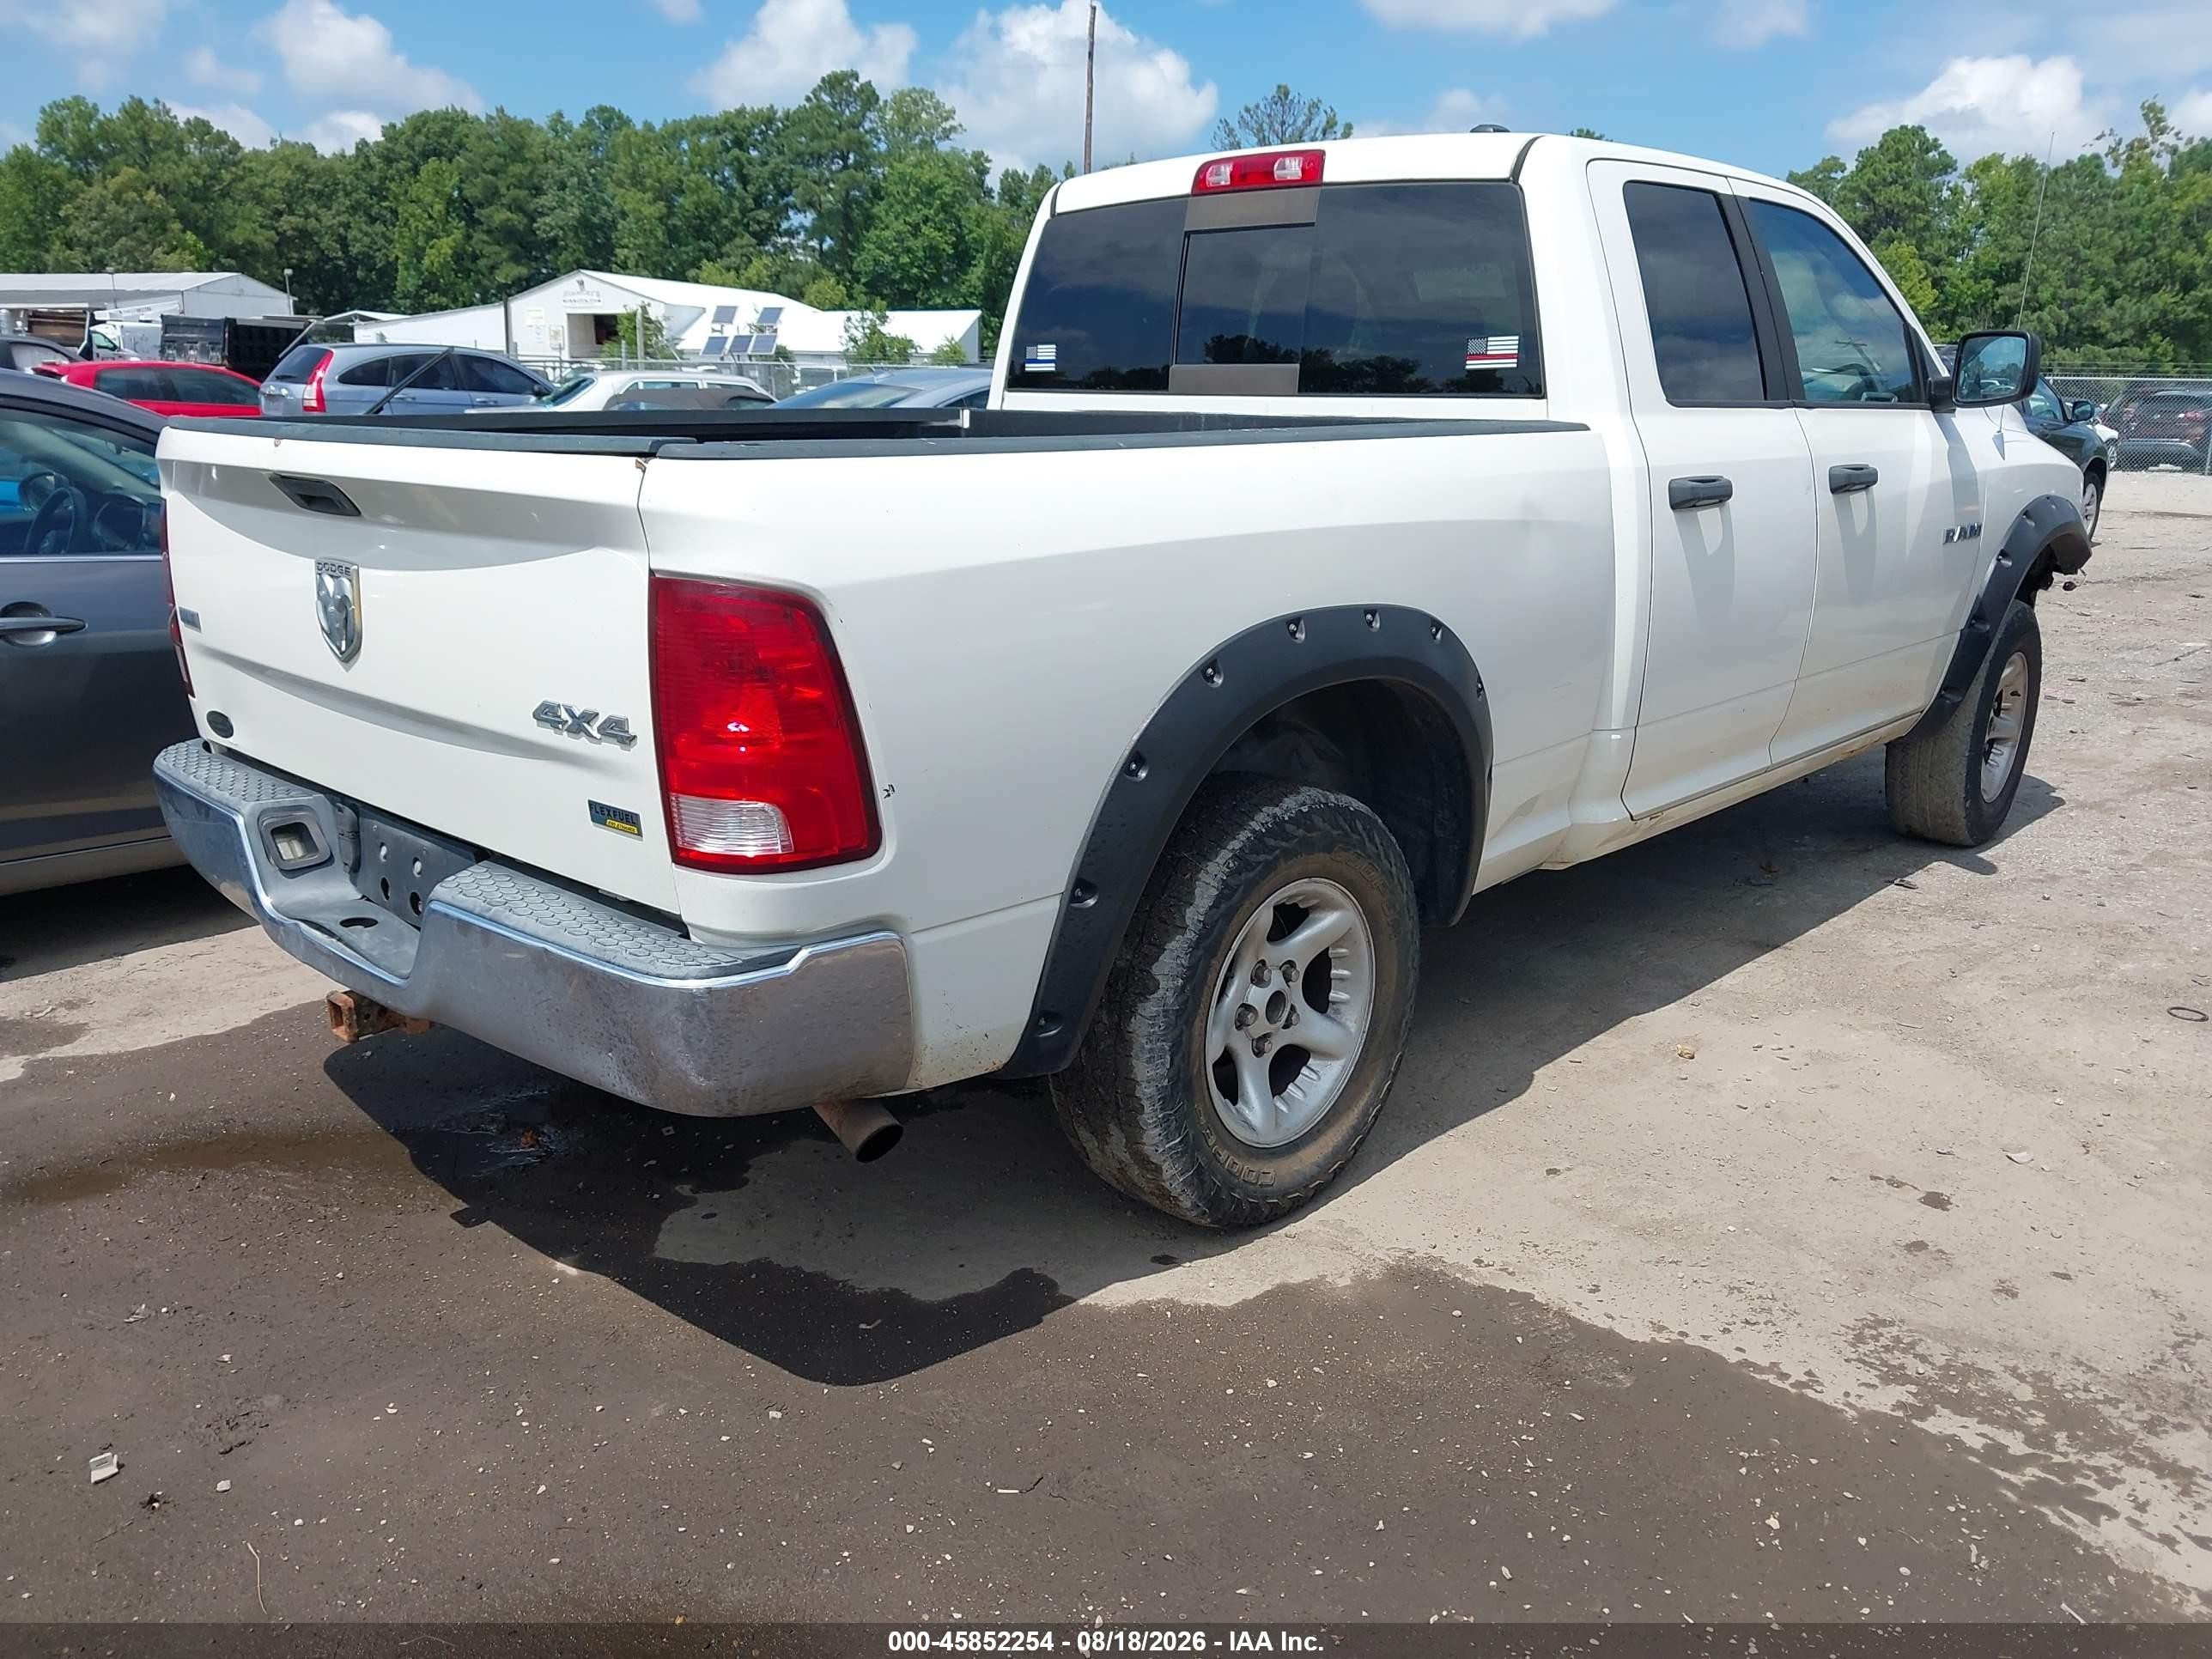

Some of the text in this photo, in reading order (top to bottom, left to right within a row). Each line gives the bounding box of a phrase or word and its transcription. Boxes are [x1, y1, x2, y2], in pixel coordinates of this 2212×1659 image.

[1943, 523, 1982, 544] RAM
[316, 562, 351, 576] DODGE
[532, 700, 637, 749] 4X4
[1194, 1103, 1277, 1187] COOPER
